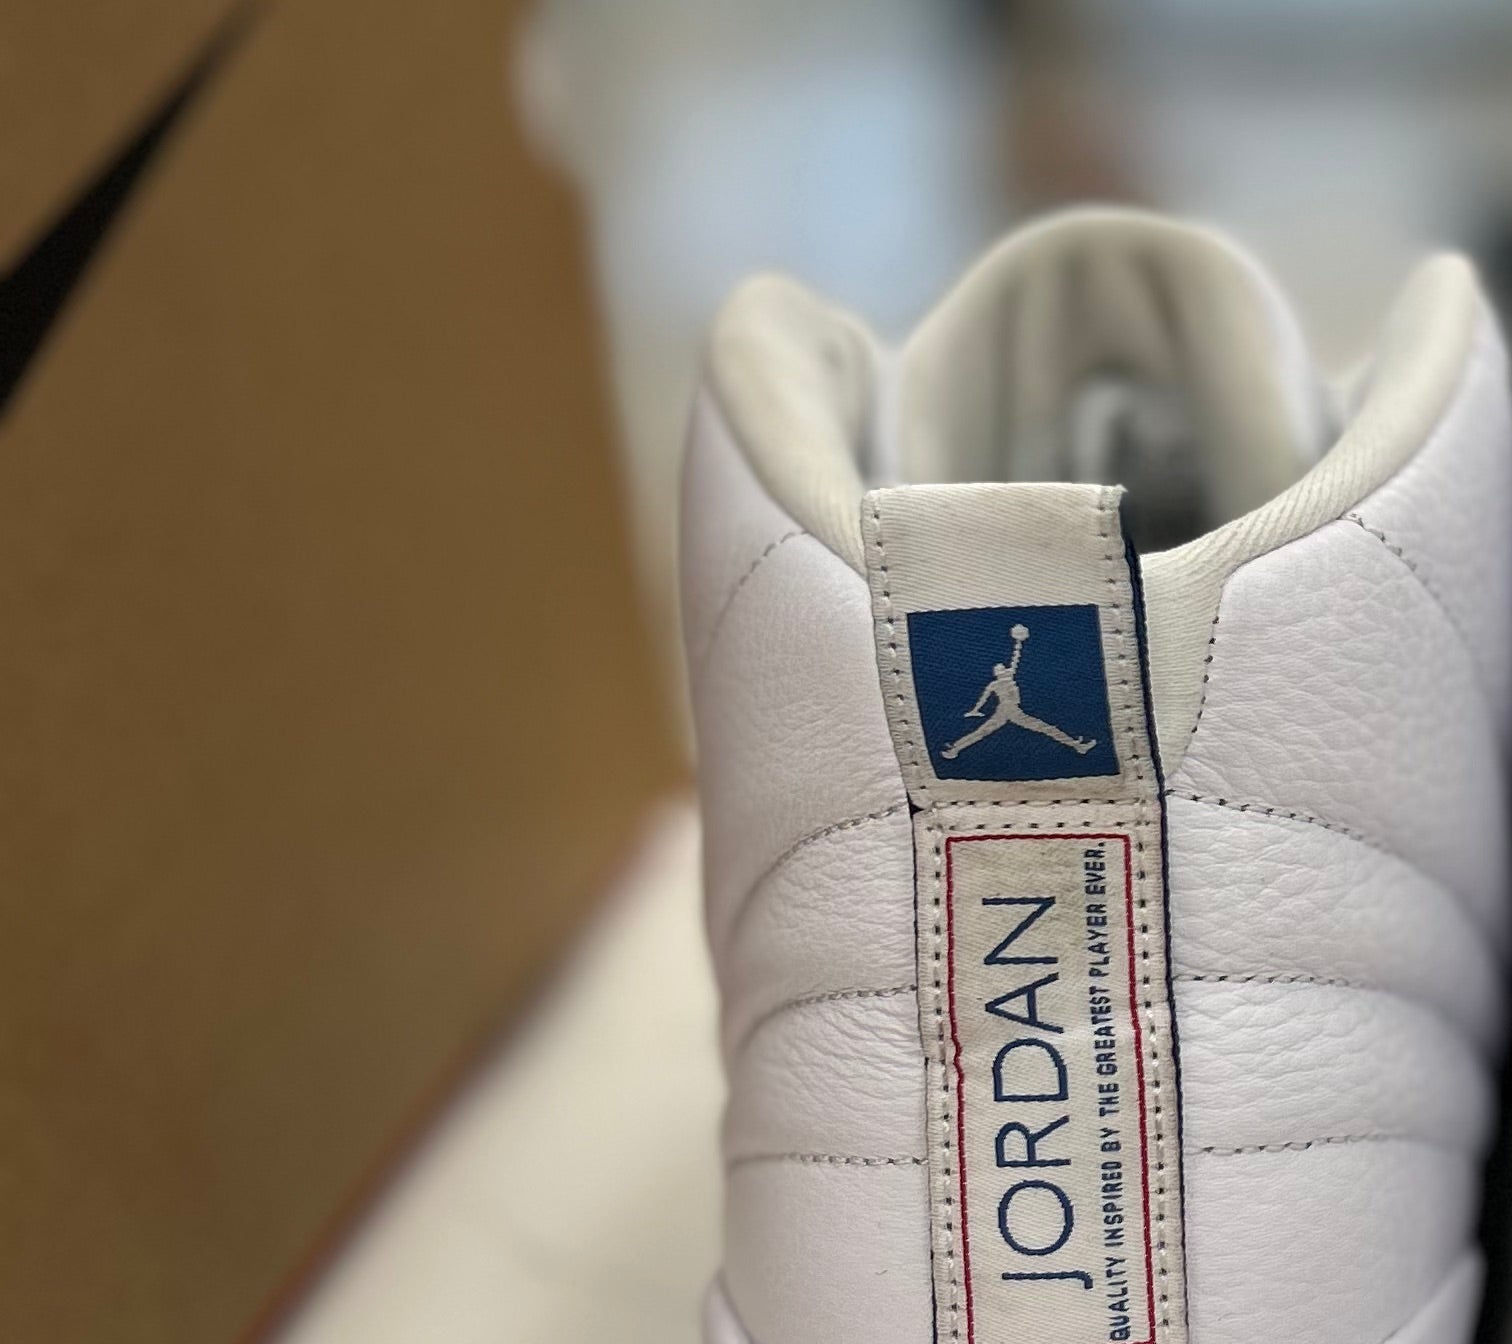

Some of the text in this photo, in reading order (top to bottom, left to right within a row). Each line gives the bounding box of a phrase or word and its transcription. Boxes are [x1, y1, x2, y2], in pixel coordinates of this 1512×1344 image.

[982, 896, 1094, 1289] JORDAN
[1084, 842, 1131, 1341] QUALITY INSPIRED BY THE GREATEST PLAYER EVER.
